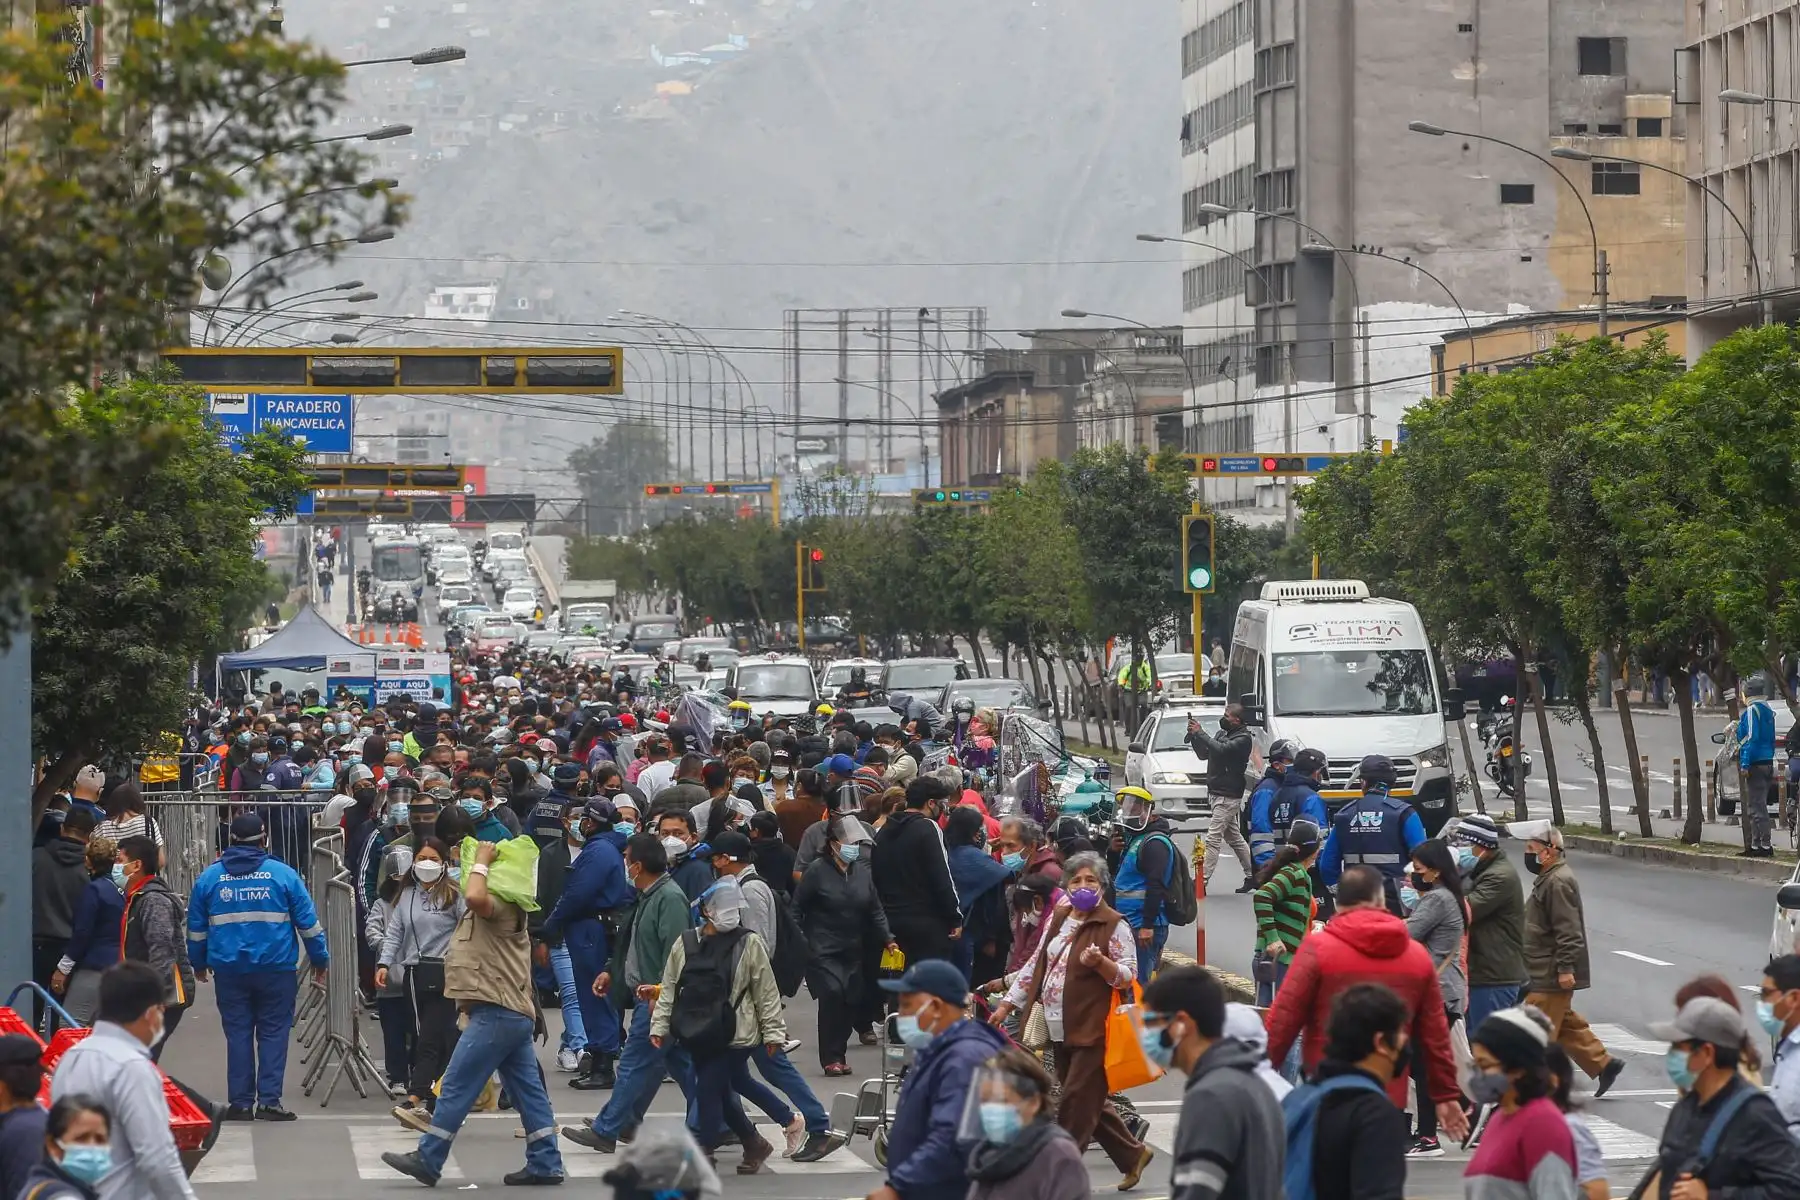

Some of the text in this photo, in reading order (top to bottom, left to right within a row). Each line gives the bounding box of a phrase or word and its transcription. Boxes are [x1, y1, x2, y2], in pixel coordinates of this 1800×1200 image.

[267, 400, 341, 413] PARADERO
[1327, 625, 1403, 637] LIMA
[1349, 811, 1383, 827] ATU
[240, 891, 271, 900] LIMA
